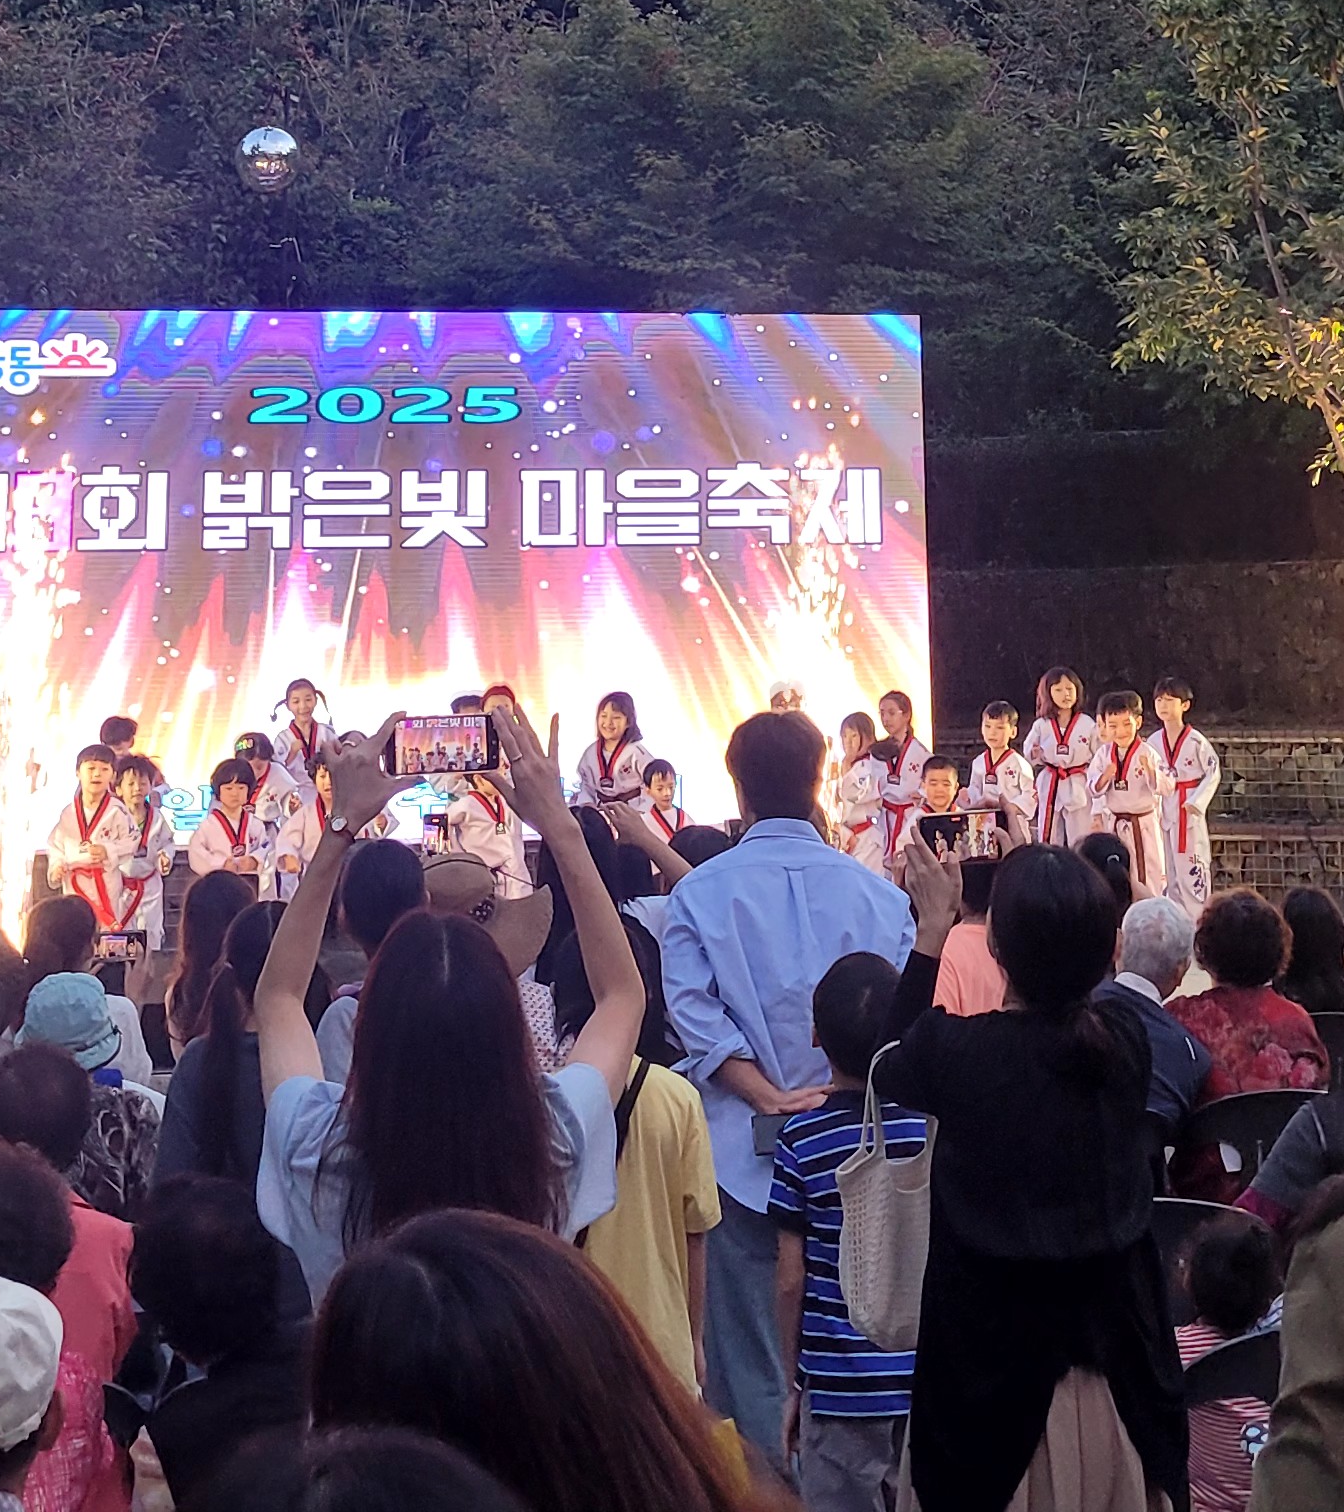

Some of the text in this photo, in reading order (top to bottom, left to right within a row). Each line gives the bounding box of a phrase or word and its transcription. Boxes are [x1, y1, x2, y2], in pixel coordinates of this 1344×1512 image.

[248, 386, 522, 424] 2025
[201, 469, 488, 551] 밝은빛
[519, 462, 884, 548] 마을축제
